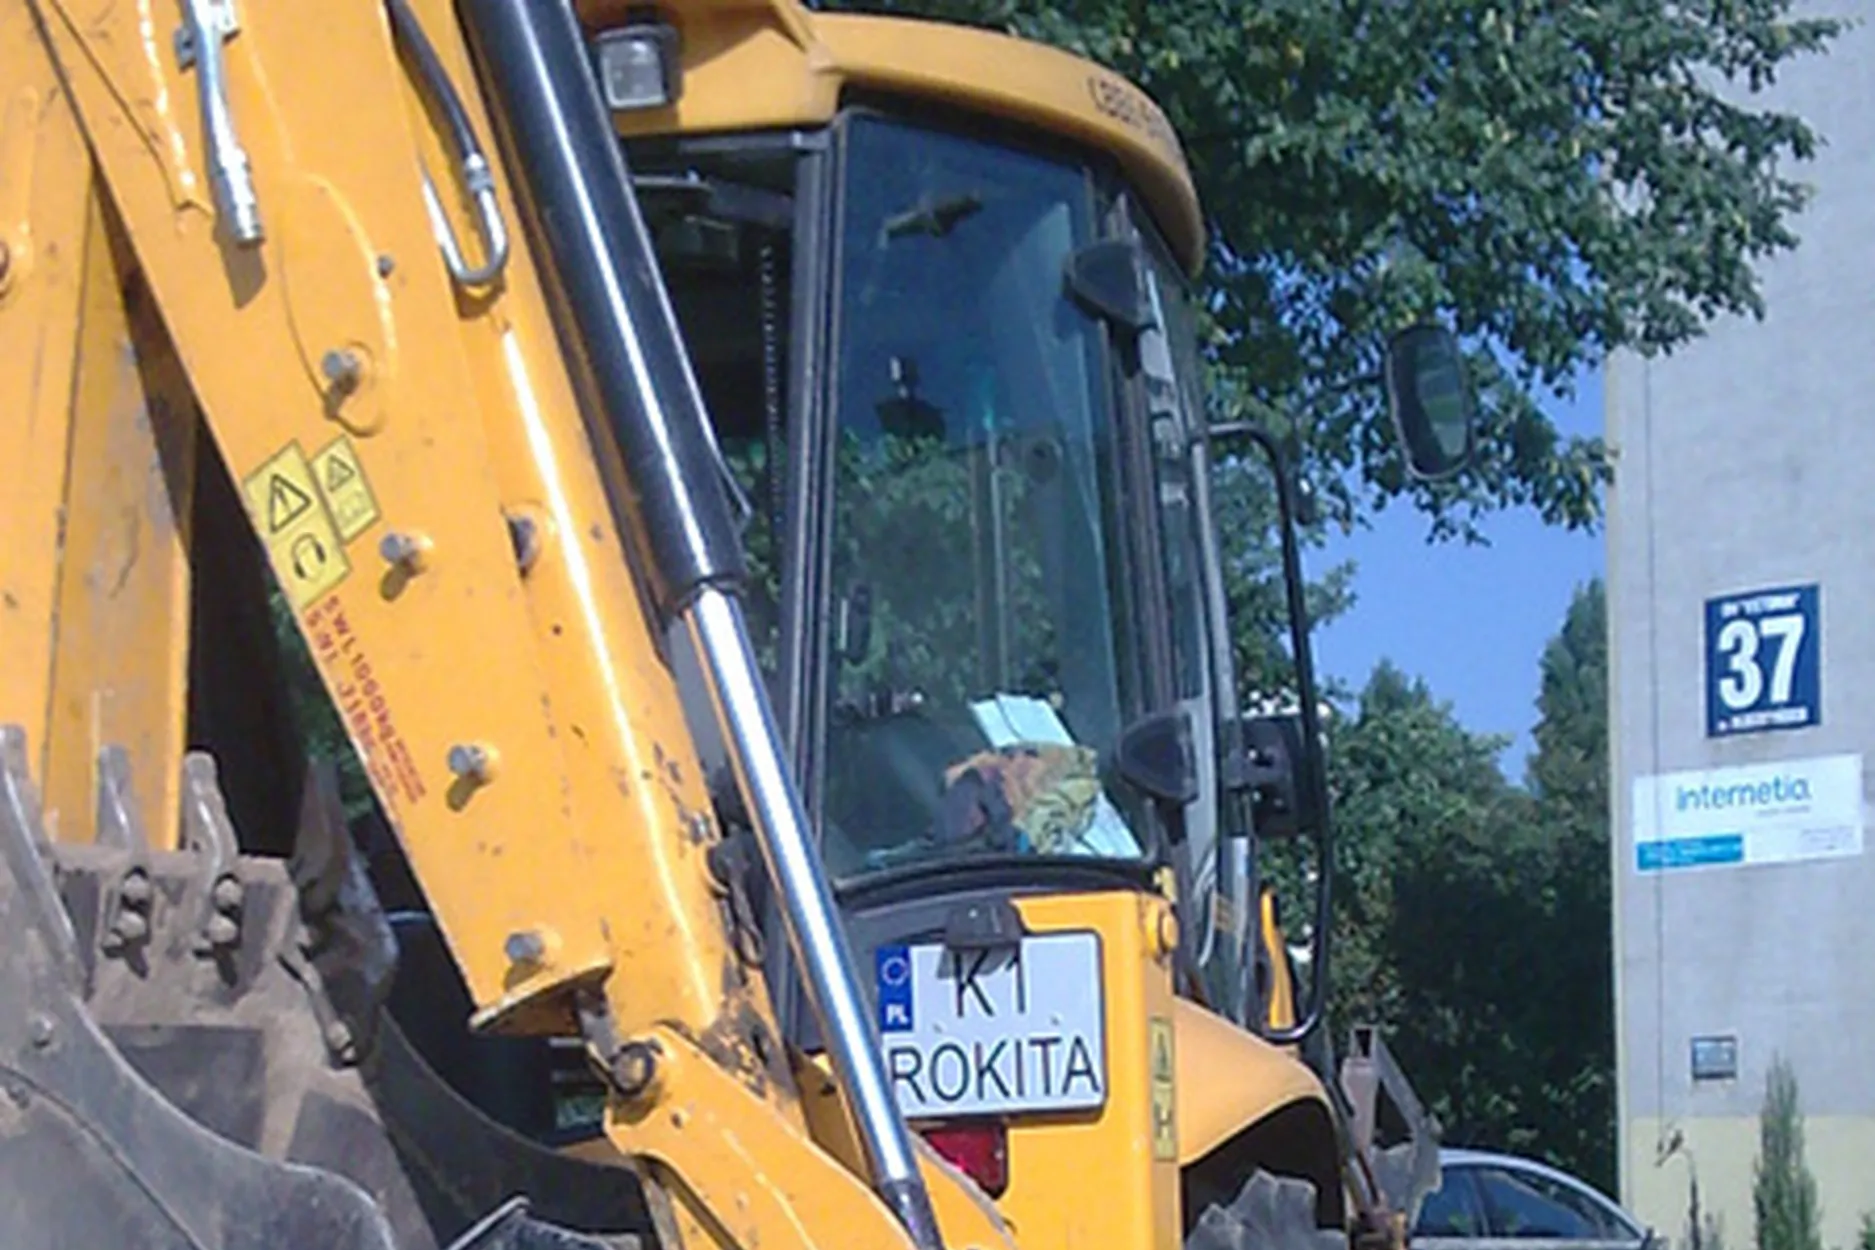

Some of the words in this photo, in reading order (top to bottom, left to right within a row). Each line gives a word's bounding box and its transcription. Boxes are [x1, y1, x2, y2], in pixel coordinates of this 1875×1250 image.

[1717, 614, 1805, 709] 37
[954, 945, 1025, 1018] K1
[888, 1035, 1100, 1103] ROKITA
